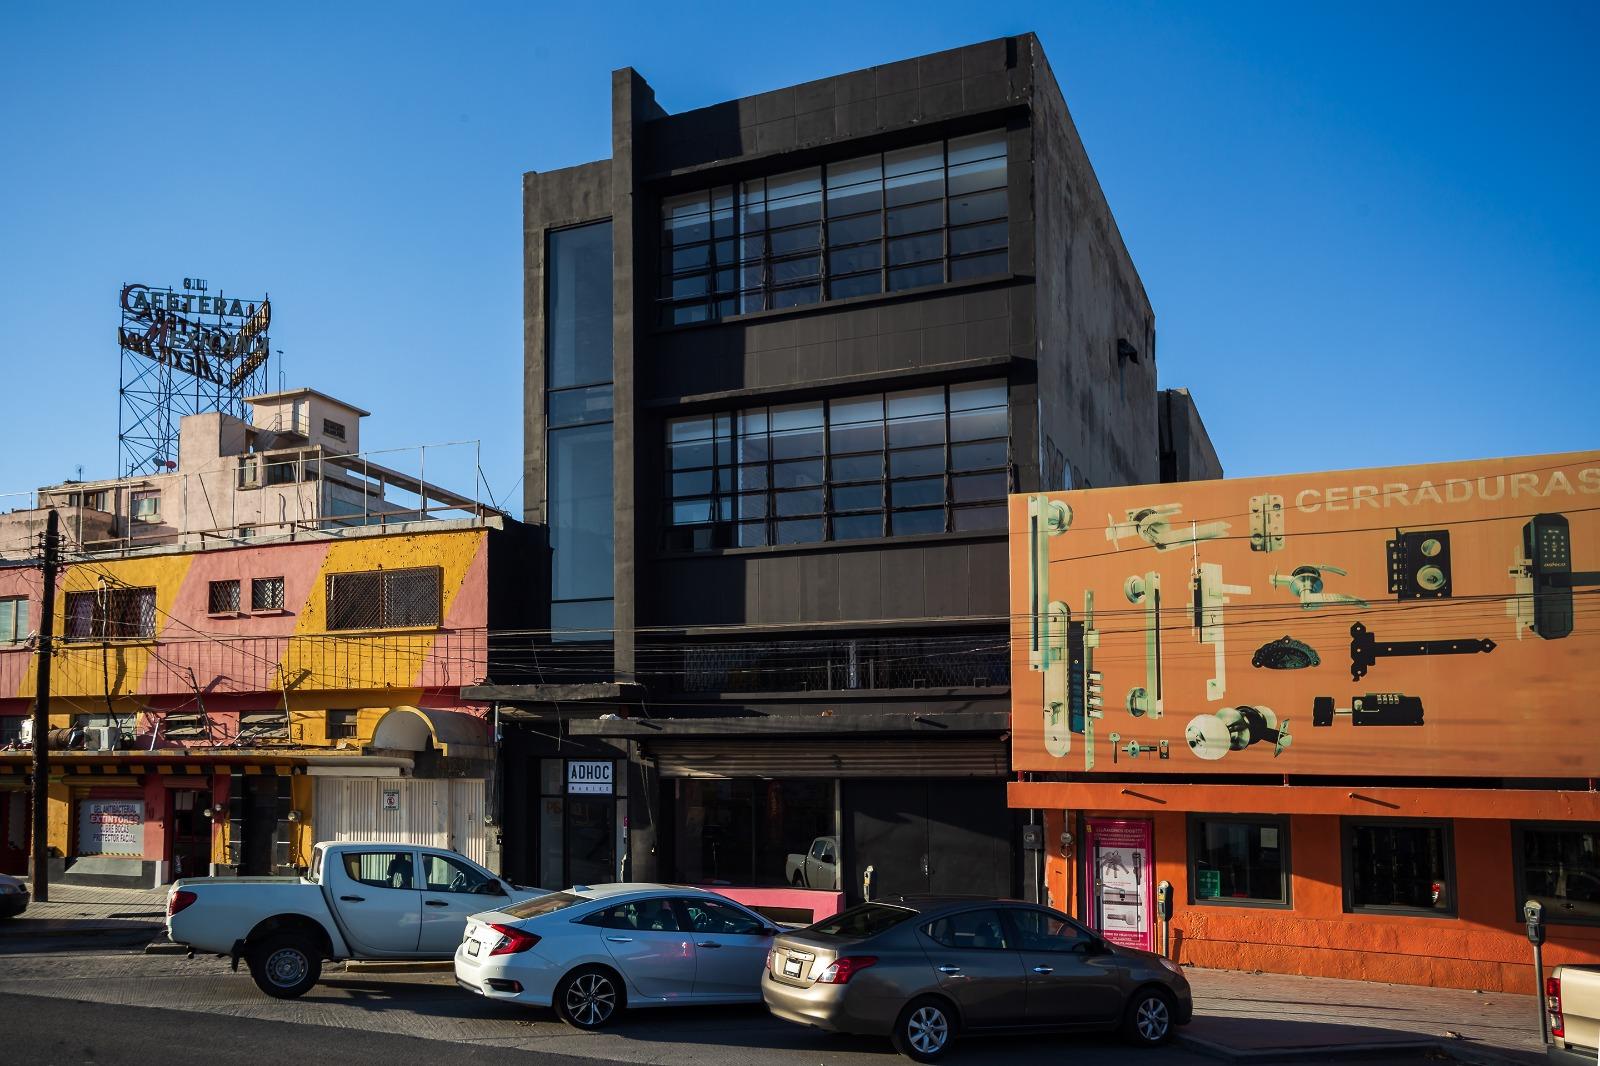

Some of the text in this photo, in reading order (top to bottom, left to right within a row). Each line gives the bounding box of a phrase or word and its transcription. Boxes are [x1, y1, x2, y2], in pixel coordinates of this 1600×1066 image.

[121, 284, 244, 316] CAFETERA
[1295, 468, 1600, 513] CERRADURAS
[571, 765, 609, 779] ADHOC
[91, 815, 139, 823] EXTINTORES
